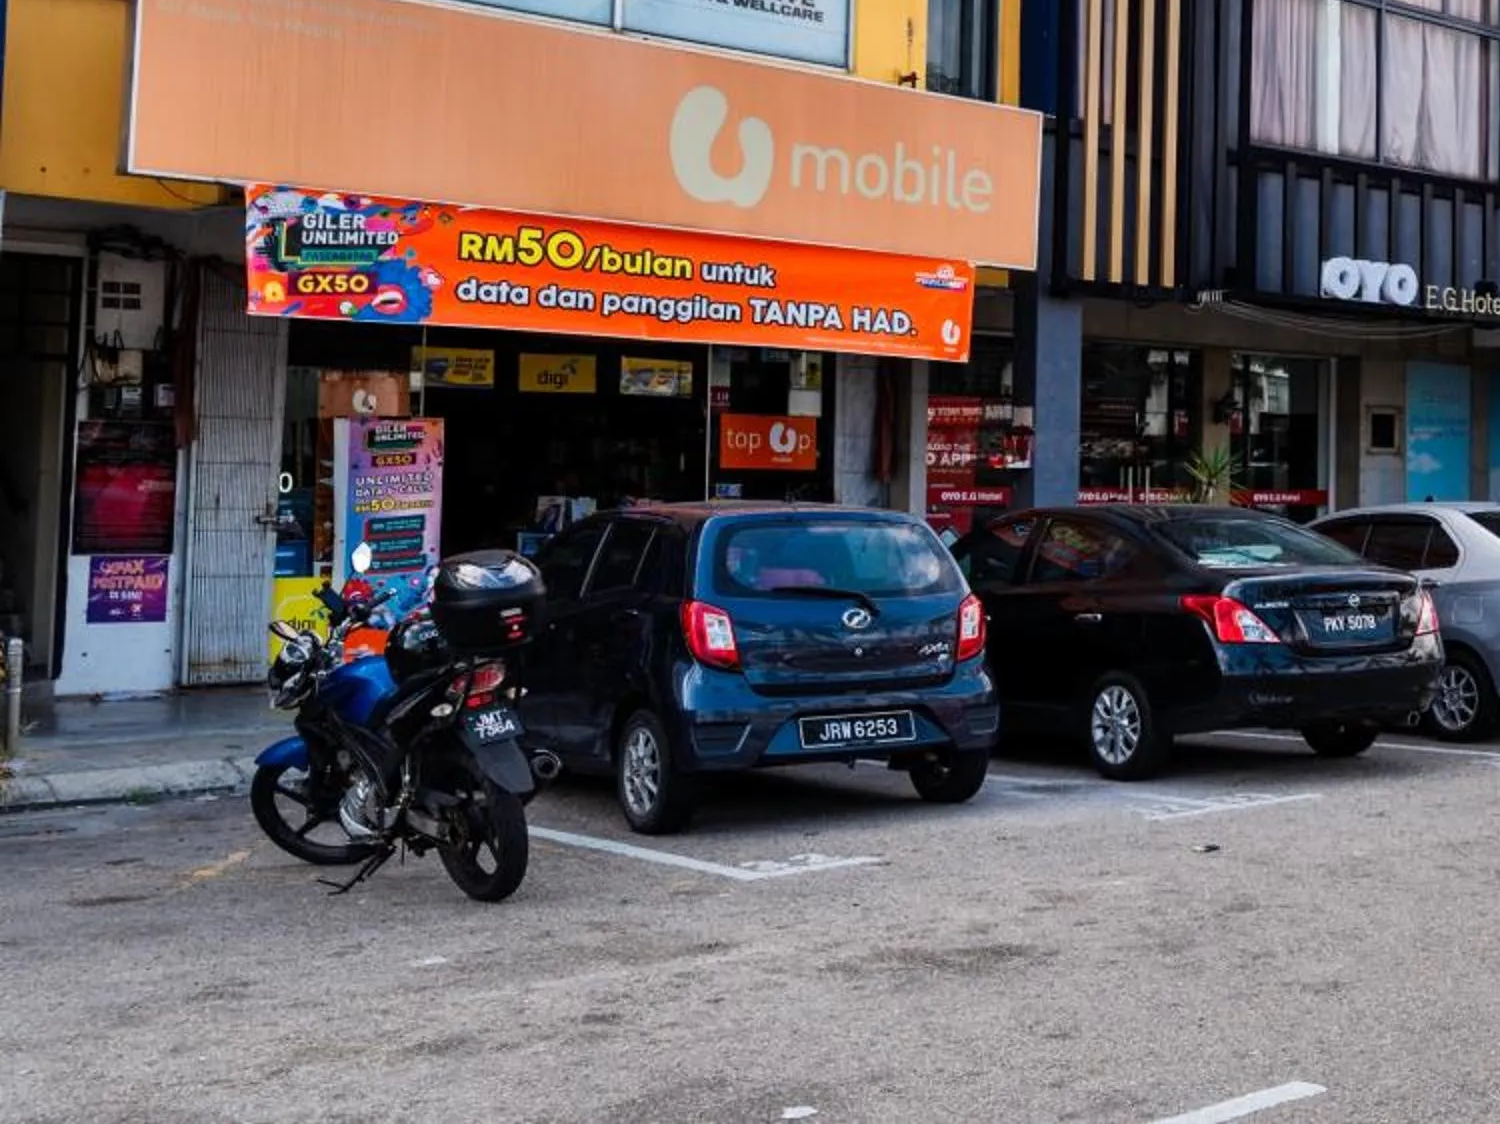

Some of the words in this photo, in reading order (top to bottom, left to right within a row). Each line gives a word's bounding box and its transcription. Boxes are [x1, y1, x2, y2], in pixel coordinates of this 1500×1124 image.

[789, 142, 994, 213] mobile
[302, 212, 366, 230] GILER
[301, 229, 400, 246] UNLIMITED
[458, 227, 692, 278] RM50/bulan
[700, 258, 777, 288] untuk
[297, 274, 370, 294] GX50
[1320, 256, 1419, 306] OYO
[1425, 285, 1457, 311] E.G
[455, 279, 530, 306] data
[537, 286, 594, 311] dan
[601, 293, 743, 323] panggilan
[750, 298, 844, 331] TANPA
[851, 305, 919, 336] HAD.
[727, 427, 762, 456] top
[820, 722, 851, 741] JRW
[854, 718, 898, 737] 6253
